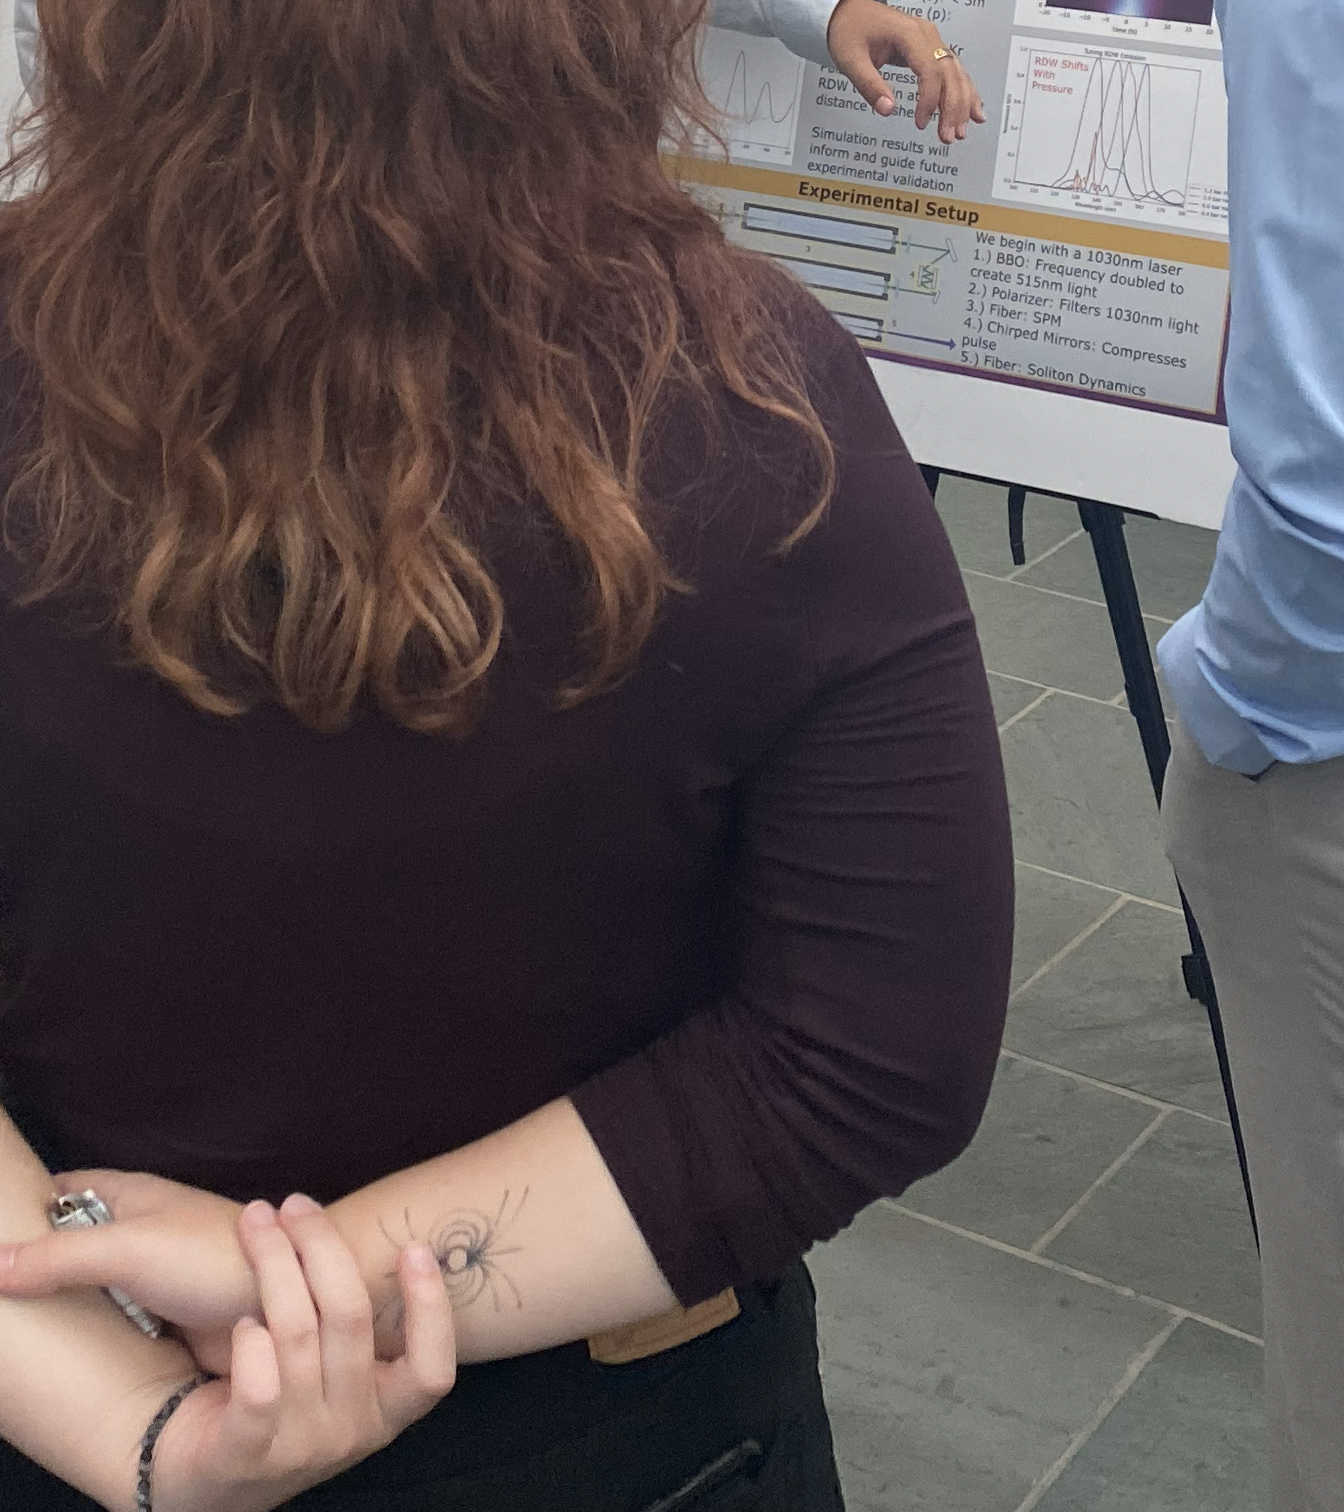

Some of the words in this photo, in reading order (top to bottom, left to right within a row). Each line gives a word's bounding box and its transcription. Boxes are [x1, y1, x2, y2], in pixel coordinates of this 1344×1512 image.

[1034, 69, 1055, 80] With
[1035, 57, 1058, 68] RDW
[1061, 59, 1089, 72] Shifts
[1032, 80, 1074, 96] Pressure
[812, 127, 877, 147] Simulation
[882, 137, 924, 154] results
[928, 143, 949, 157] will
[807, 160, 888, 182] experimental
[893, 174, 954, 192] validation
[810, 144, 850, 160] inform
[854, 150, 877, 164] and
[881, 154, 915, 170] guide
[920, 159, 958, 176] future
[798, 182, 919, 214] Experimental
[925, 201, 979, 224] Setup
[975, 231, 996, 246] We
[999, 235, 1036, 253] begin
[1040, 239, 1069, 257] with
[1073, 246, 1082, 258] a
[1087, 246, 1145, 270] 1030nm
[1150, 259, 1183, 277] laser
[970, 268, 1011, 283] create
[1016, 272, 1063, 290] 515nm
[1067, 280, 1098, 299] light
[1035, 257, 1106, 284] Frequency
[1110, 269, 1167, 292] doubled
[1171, 281, 1184, 295] to
[989, 303, 1027, 321] Fiber:
[1032, 310, 1062, 327] SPM
[992, 287, 1055, 309] Polarizer:
[1059, 296, 1102, 316] Filters
[1106, 305, 1164, 327] 1030nm
[1167, 316, 1199, 336] light
[962, 333, 997, 351] pulse
[987, 319, 1040, 342] Chirped
[1043, 327, 1097, 350] Mirrors:
[1102, 340, 1187, 370] Compresses
[983, 354, 1022, 372] Fiber:
[1027, 362, 1075, 381] Soliton
[1079, 371, 1146, 397] Dynamics
